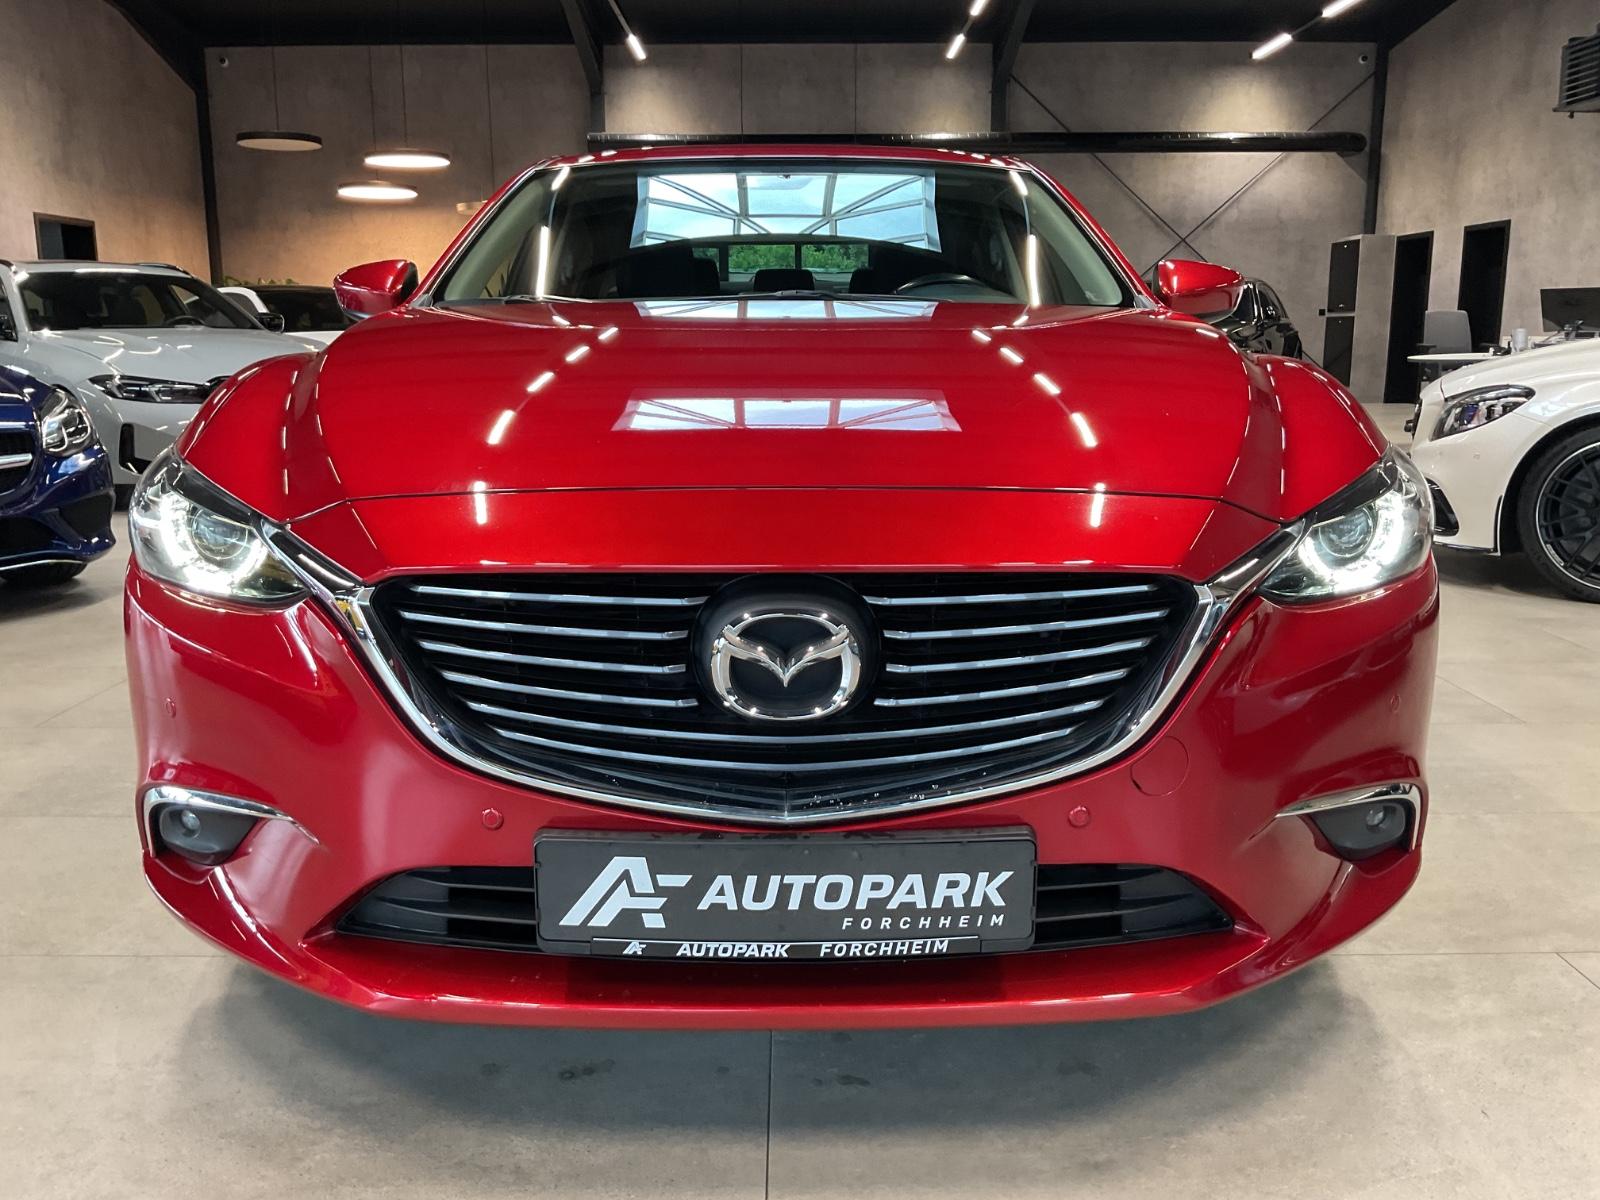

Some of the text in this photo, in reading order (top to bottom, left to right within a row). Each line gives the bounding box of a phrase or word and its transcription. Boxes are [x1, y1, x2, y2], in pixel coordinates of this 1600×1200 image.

[696, 870, 1015, 911] AUTOPARK
[841, 913, 1006, 930] FORCHHEIM
[676, 942, 789, 958] AUTOPARK
[819, 939, 950, 958] FORCHHEIM
